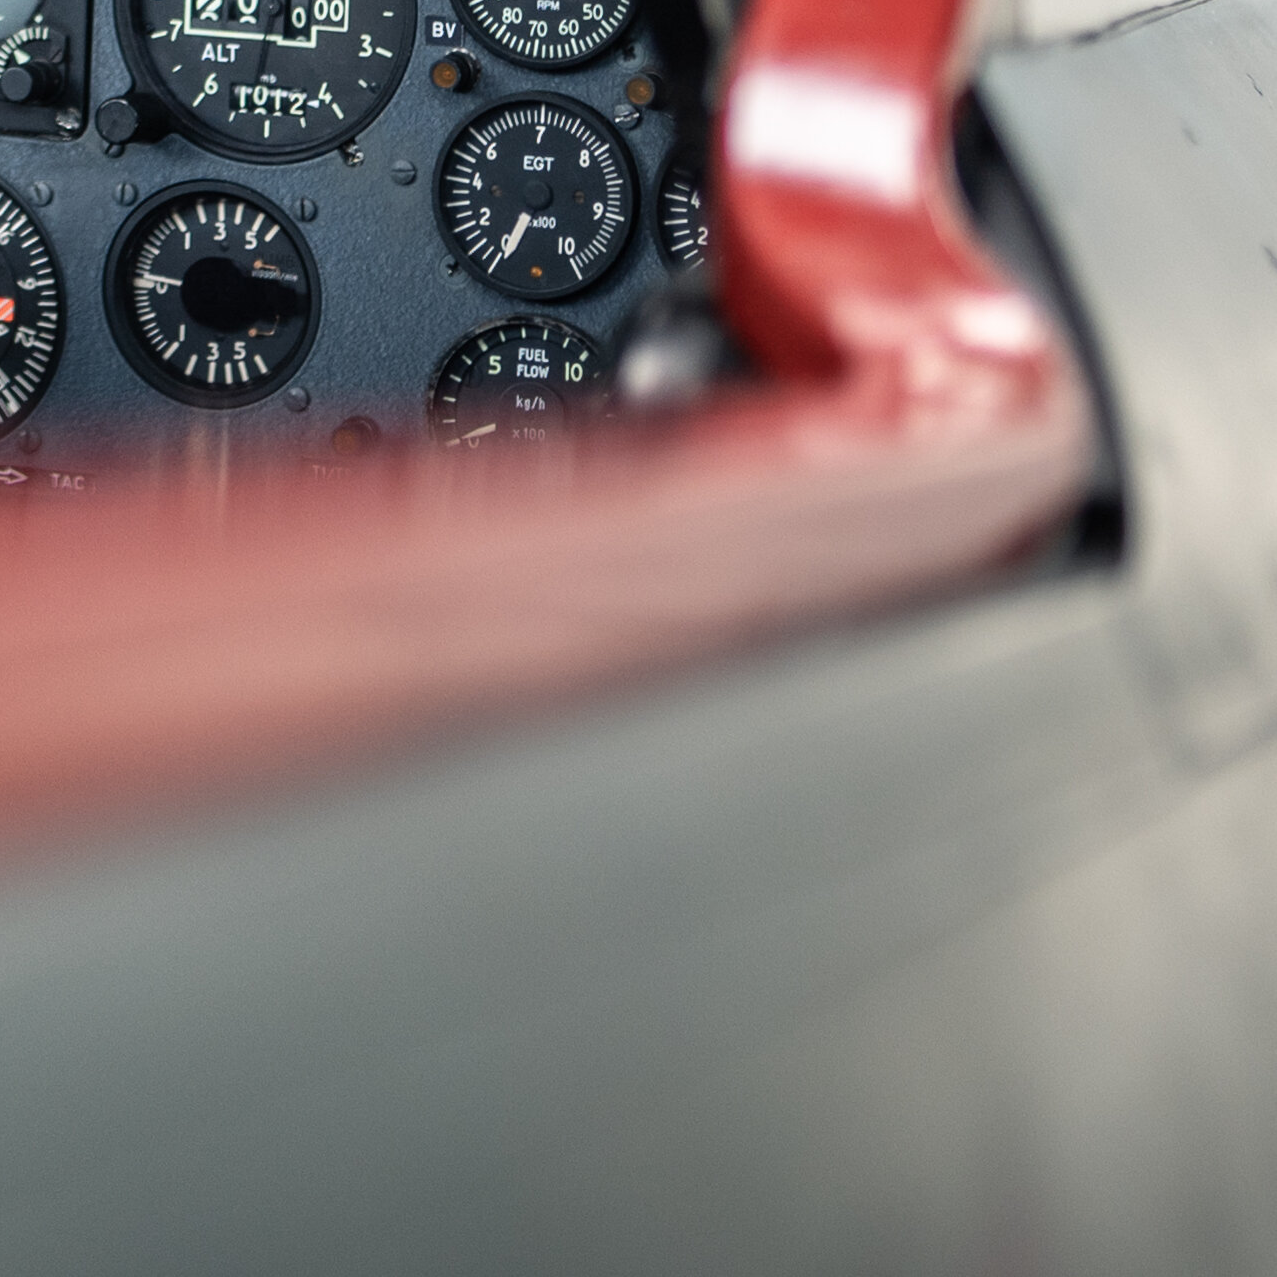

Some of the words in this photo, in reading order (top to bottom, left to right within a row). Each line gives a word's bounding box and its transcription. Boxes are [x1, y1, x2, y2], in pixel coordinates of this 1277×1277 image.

[537, 0, 560, 11] RPM
[583, 5, 603, 21] 50
[502, 7, 522, 24] 80
[169, 20, 182, 41] 7
[431, 23, 457, 38] BV
[528, 20, 548, 36] 70
[558, 20, 579, 36] 60
[201, 44, 240, 62] ALT
[359, 34, 372, 57] 3
[204, 73, 218, 95] 6
[319, 82, 332, 104] 4
[536, 126, 544, 144] 7
[486, 142, 497, 160] 6
[579, 149, 590, 168] 8
[523, 156, 554, 171] EGT
[472, 173, 483, 191] 4
[479, 208, 490, 226] 2
[593, 202, 603, 220] 9
[214, 222, 227, 240] 3
[245, 232, 258, 250] 5
[558, 237, 575, 255] 10
[15, 326, 36, 348] 12
[207, 343, 219, 361] 3
[233, 341, 246, 359] 5
[518, 348, 549, 363] FUEL
[488, 356, 502, 374] 5
[516, 364, 549, 379] FLOW
[564, 362, 583, 381] 10
[515, 395, 546, 411] kg/h
